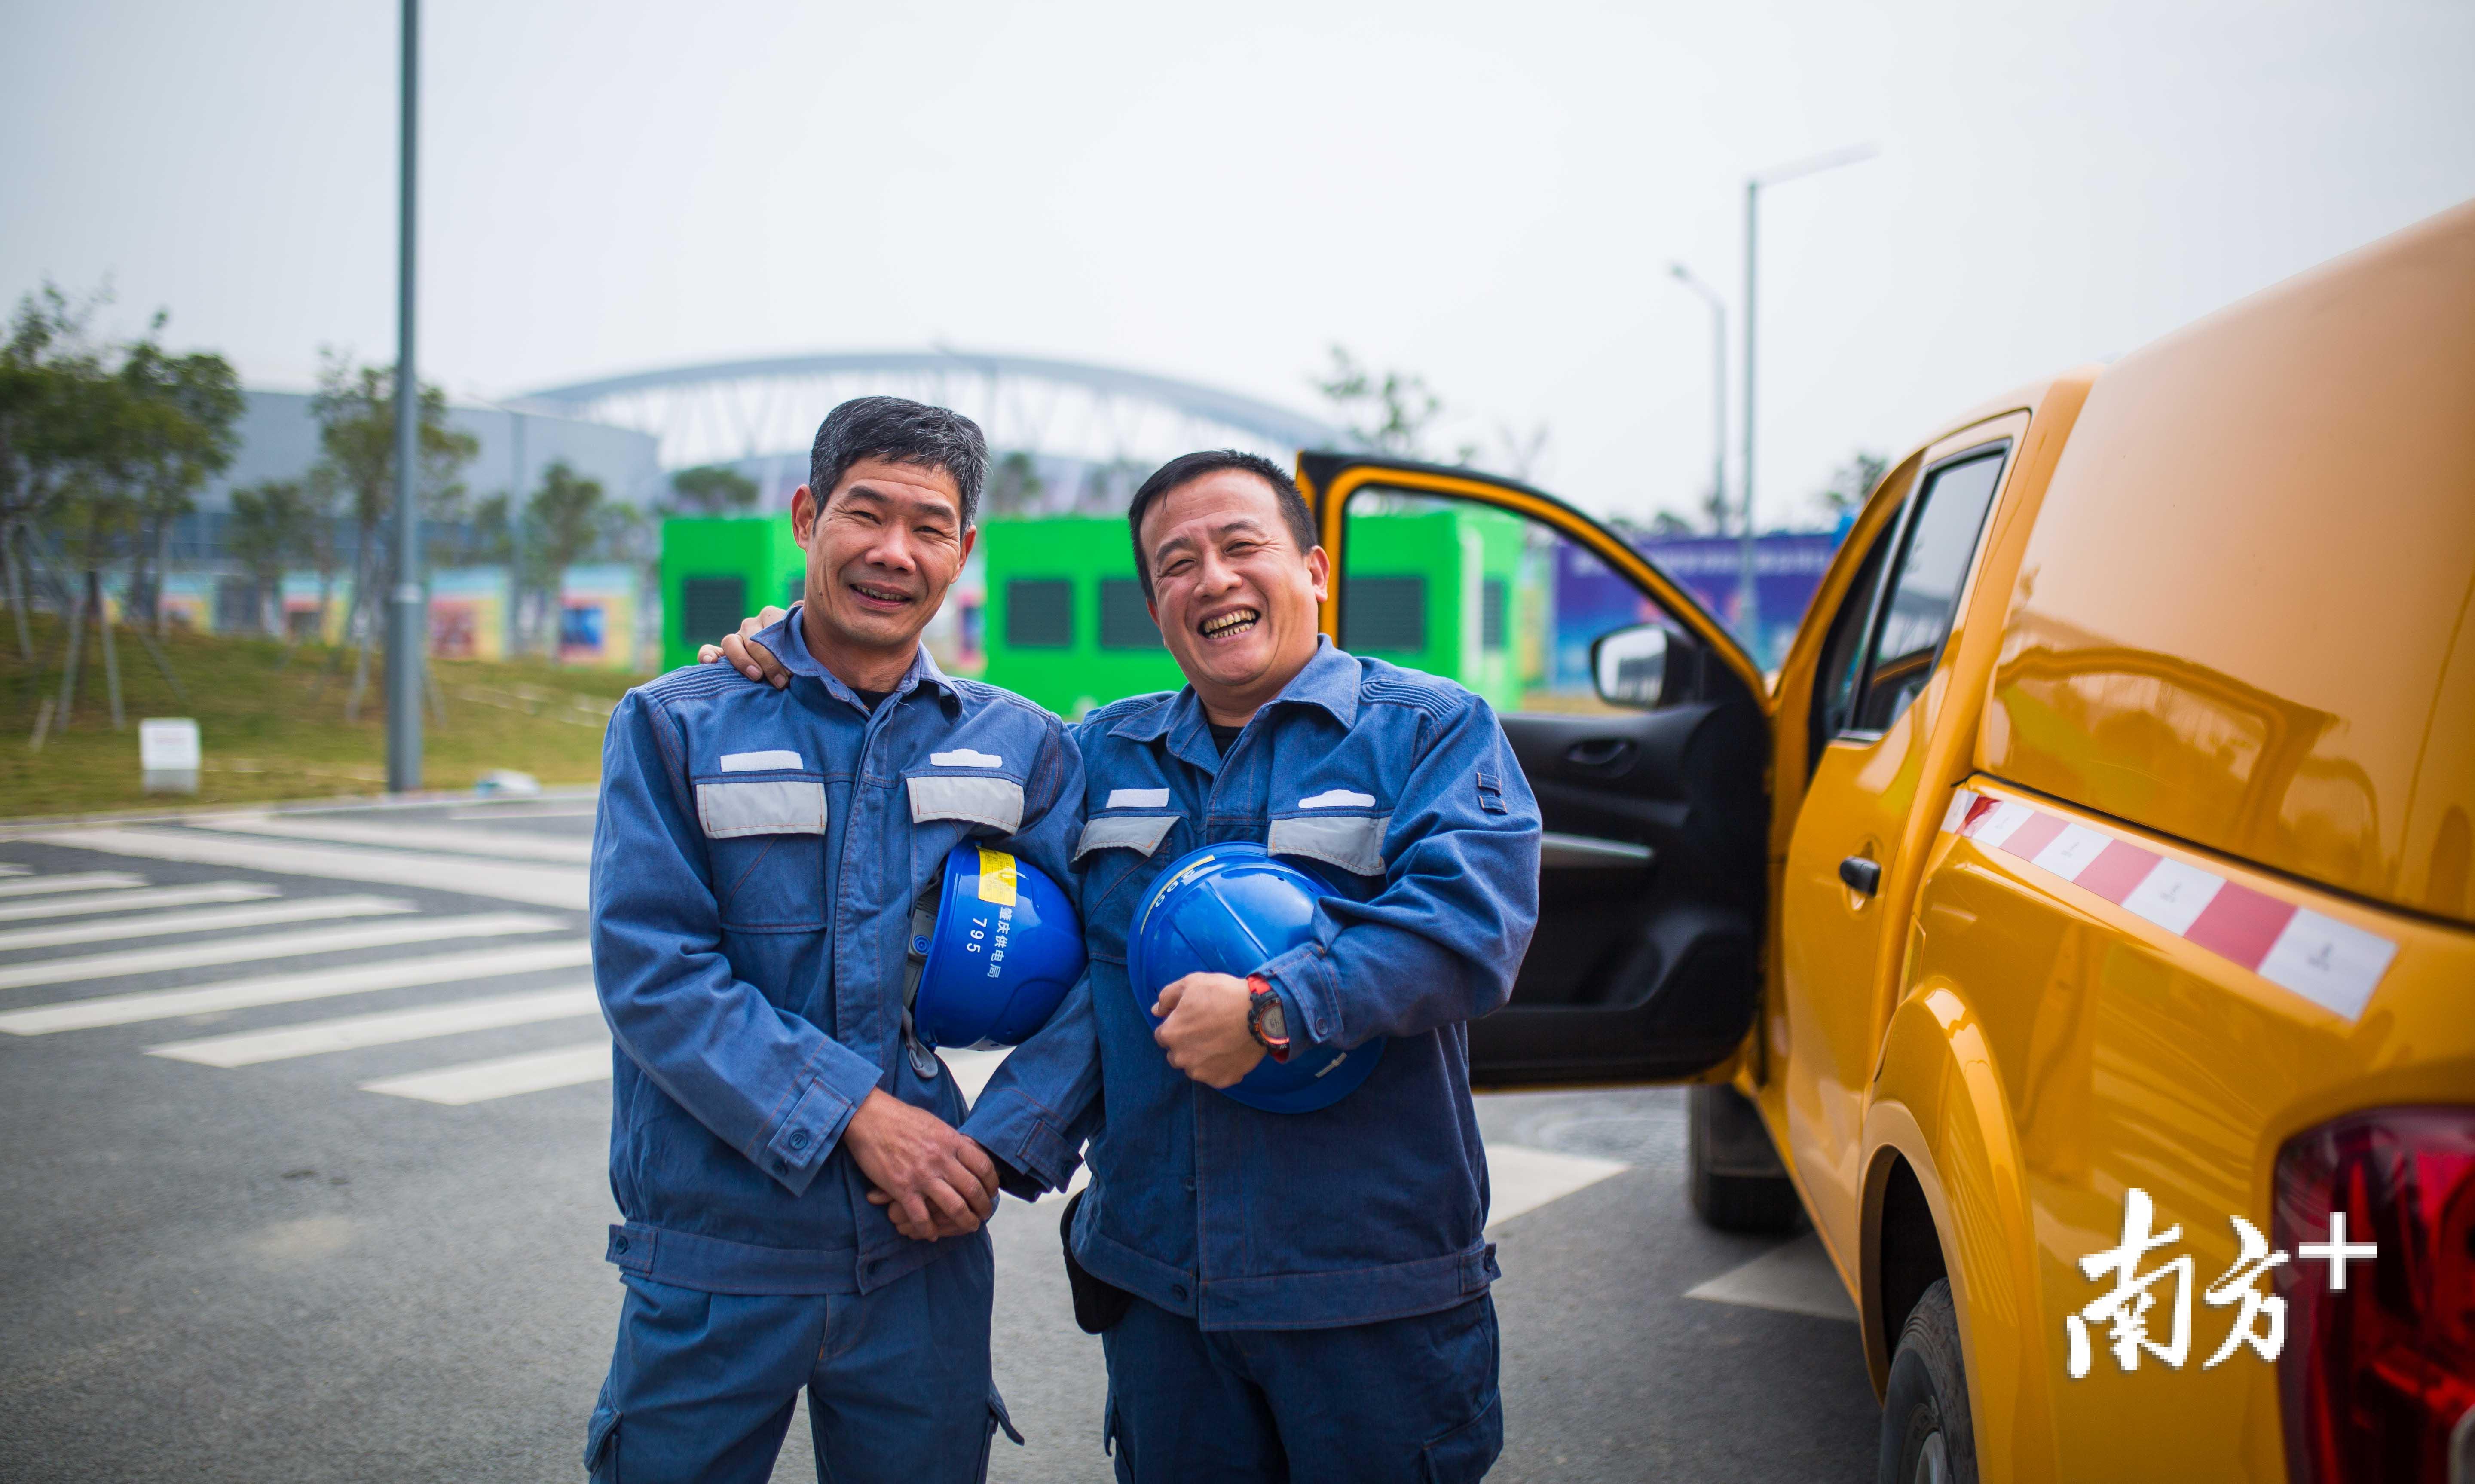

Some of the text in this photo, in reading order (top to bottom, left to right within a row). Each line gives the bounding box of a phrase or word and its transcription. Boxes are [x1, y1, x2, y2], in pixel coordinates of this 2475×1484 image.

[967, 918, 988, 953] 795
[987, 906, 1013, 979] 肇庆供电局
